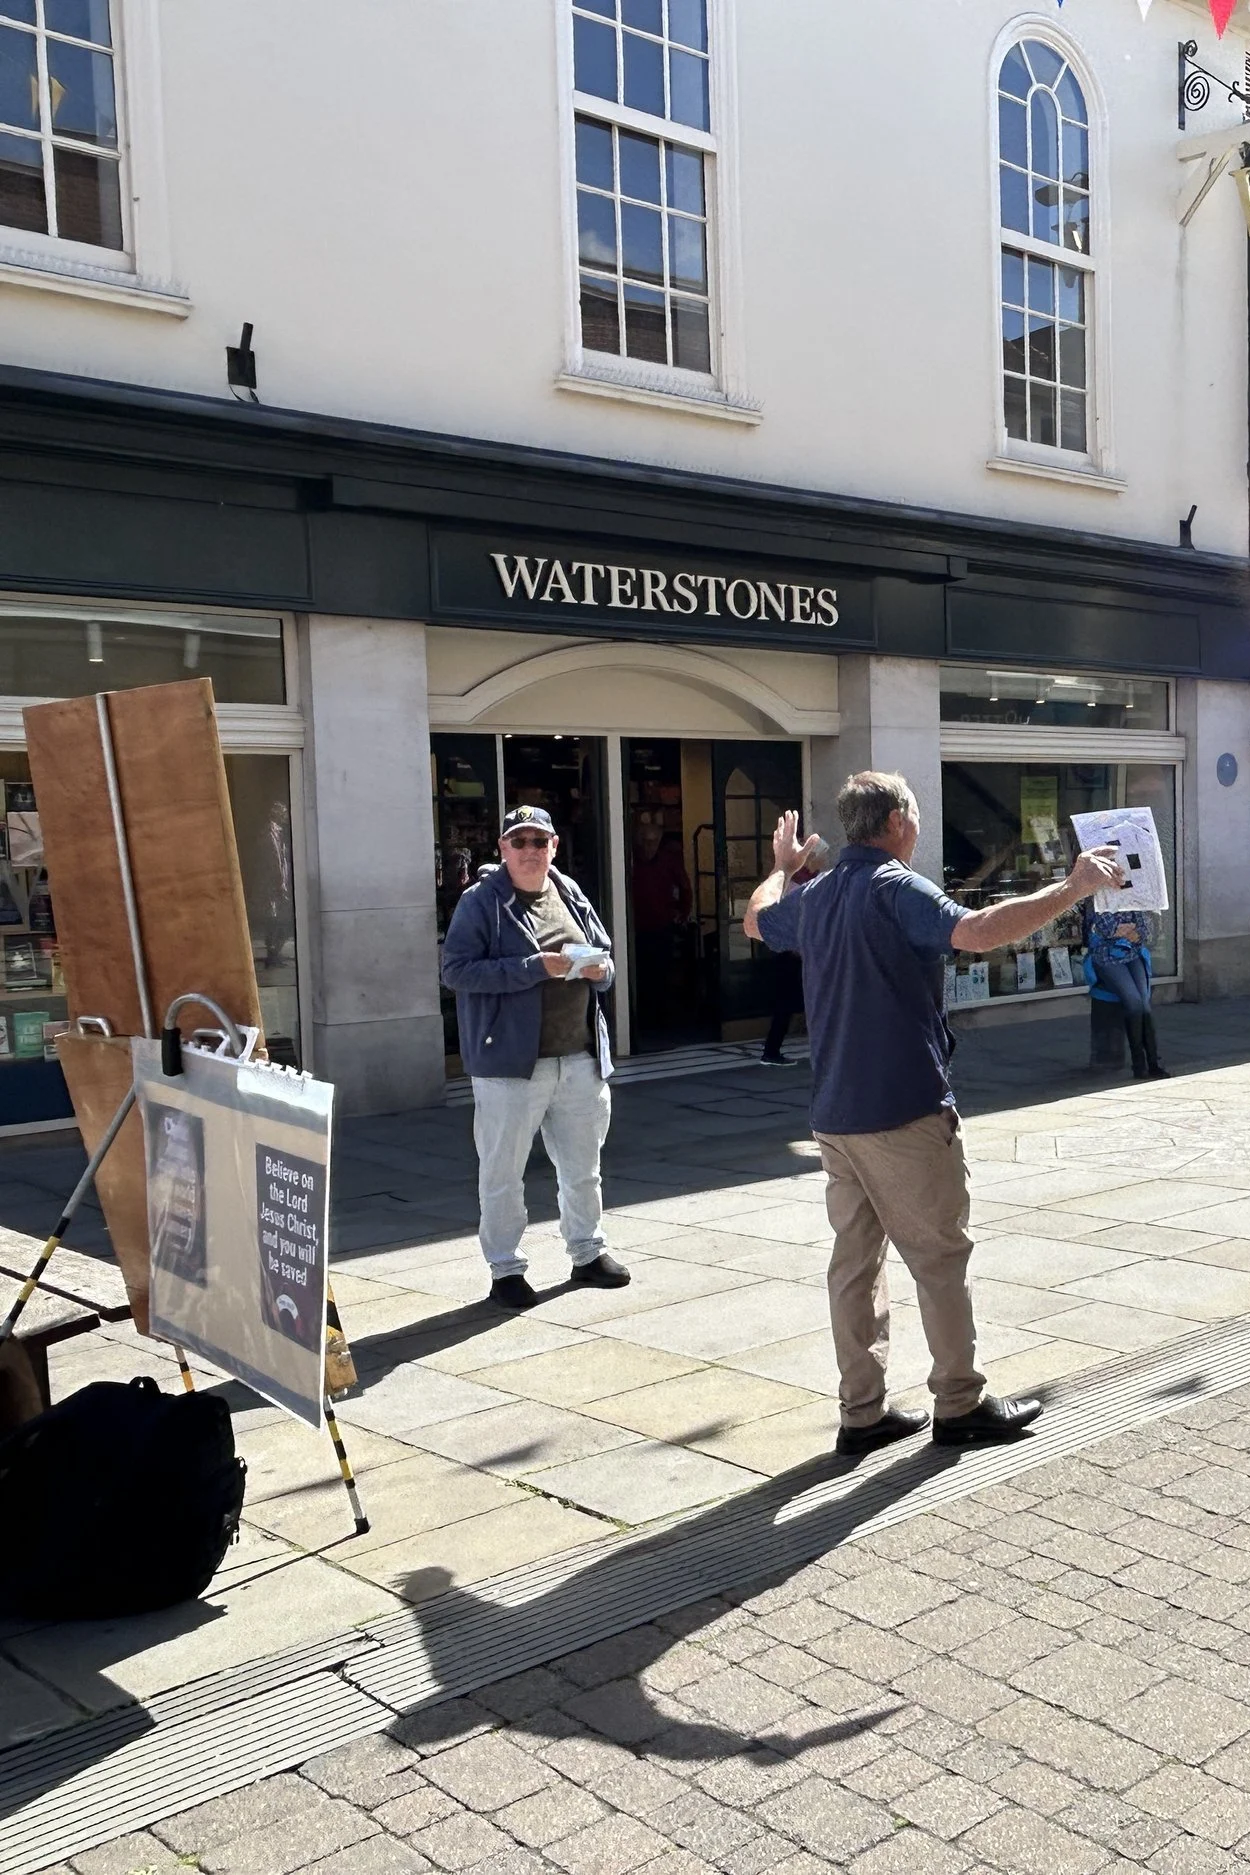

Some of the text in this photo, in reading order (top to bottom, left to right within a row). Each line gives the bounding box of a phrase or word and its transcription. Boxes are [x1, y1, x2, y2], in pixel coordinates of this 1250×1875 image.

[490, 553, 840, 627] WATERSTONES
[265, 1156, 314, 1190] Believe on
[269, 1182, 308, 1213] the Lord
[260, 1202, 319, 1246] Jesus Christ,
[262, 1229, 316, 1265] and you will
[268, 1250, 307, 1286] be saved
